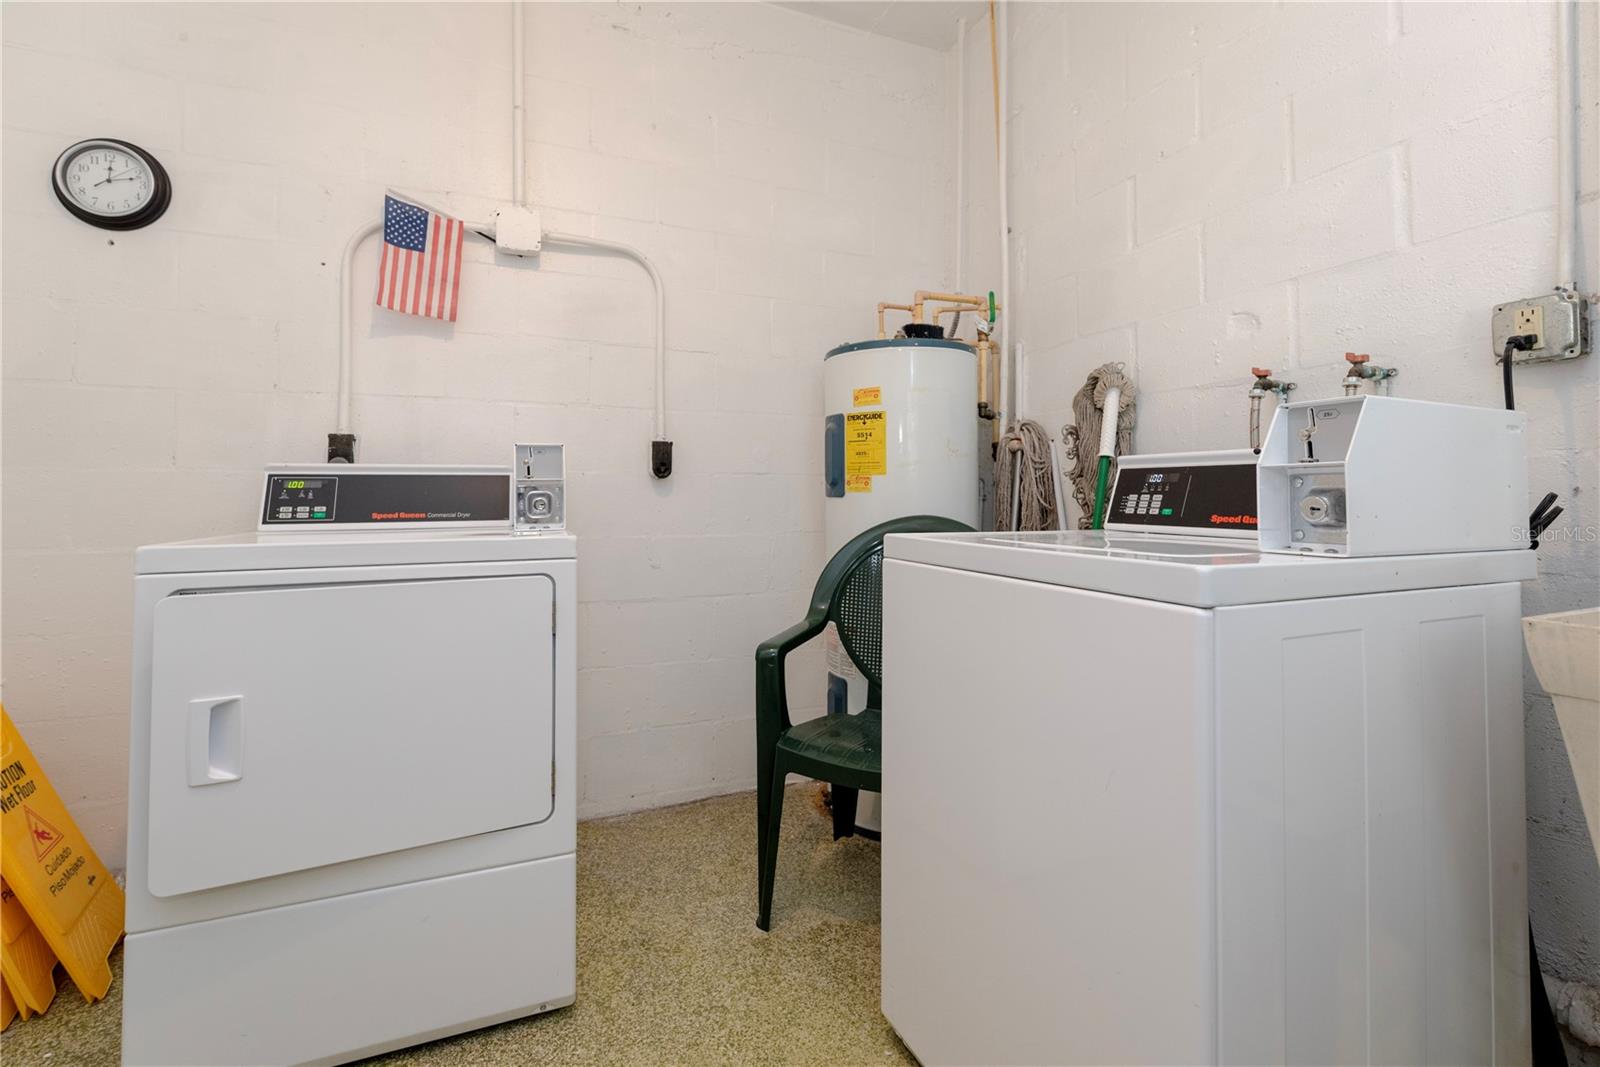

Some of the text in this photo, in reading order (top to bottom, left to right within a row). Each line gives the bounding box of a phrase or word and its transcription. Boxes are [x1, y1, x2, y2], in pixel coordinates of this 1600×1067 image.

[371, 512, 399, 520] Speed
[399, 511, 427, 519] Queen
[457, 511, 471, 519] Dryer
[1210, 514, 1242, 525] Speed
[0, 760, 26, 792] UTION
[13, 779, 37, 802] Floor
[44, 846, 72, 876] Cuidado
